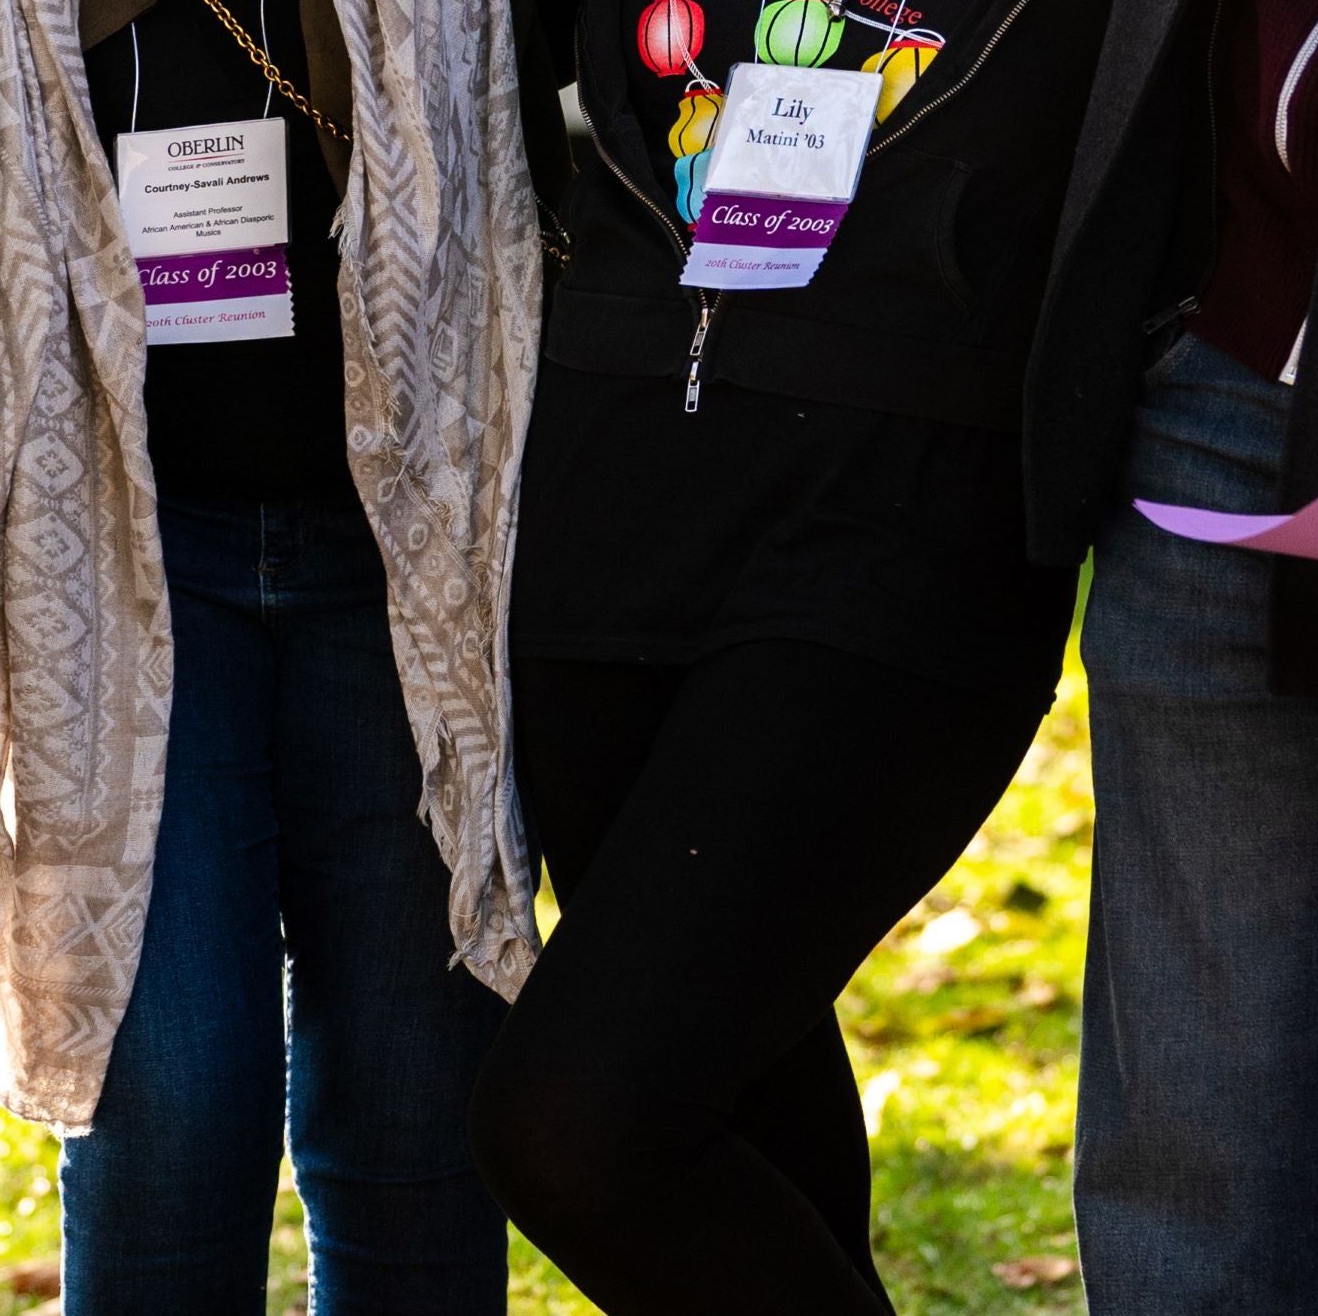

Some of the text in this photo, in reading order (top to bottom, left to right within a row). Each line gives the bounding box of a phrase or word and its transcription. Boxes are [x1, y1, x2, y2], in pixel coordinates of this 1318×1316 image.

[771, 97, 815, 125] Lily
[167, 134, 245, 157] OBERLIN
[746, 128, 825, 149] Matini '03
[144, 173, 270, 194] Courtney-Savali Andrews
[173, 205, 243, 218] Assistant Professor
[712, 205, 834, 234] Class of 2003
[141, 226, 168, 234] African
[169, 222, 204, 231] American
[213, 218, 239, 226] African
[240, 214, 274, 225] Diasporic
[196, 229, 221, 237] Musics
[138, 260, 277, 288] Class of 2003
[705, 259, 800, 270] 20th Cluster Reunion
[146, 310, 266, 327] 20th Cluster Reunion
